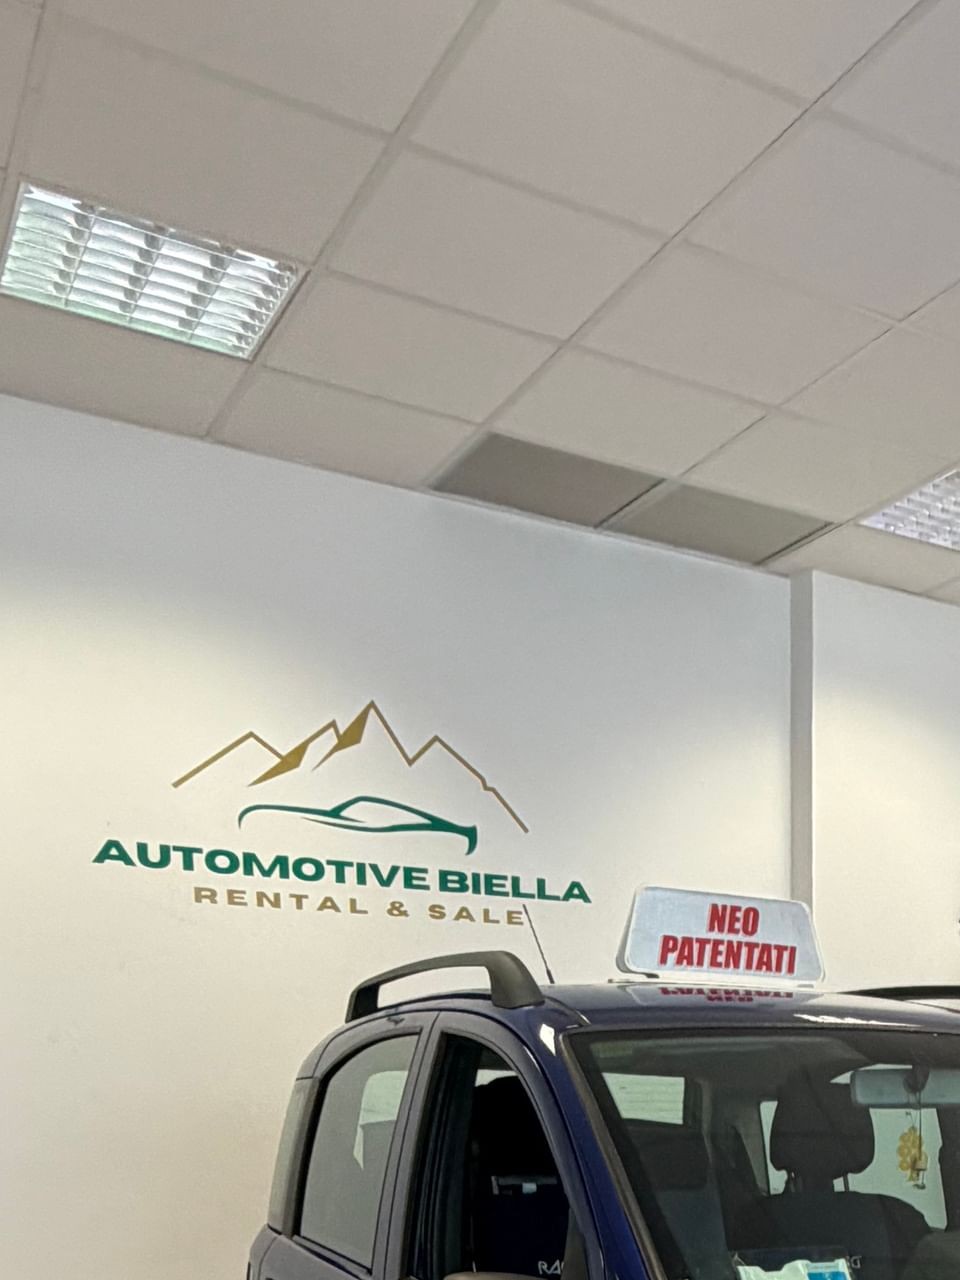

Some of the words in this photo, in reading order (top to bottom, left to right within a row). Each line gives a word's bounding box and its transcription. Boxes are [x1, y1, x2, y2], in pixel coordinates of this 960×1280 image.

[193, 887, 369, 914] RENTAL
[386, 900, 409, 918] &
[428, 904, 524, 926] SALE
[707, 903, 760, 936] NEO
[660, 934, 797, 975] PATENTATI
